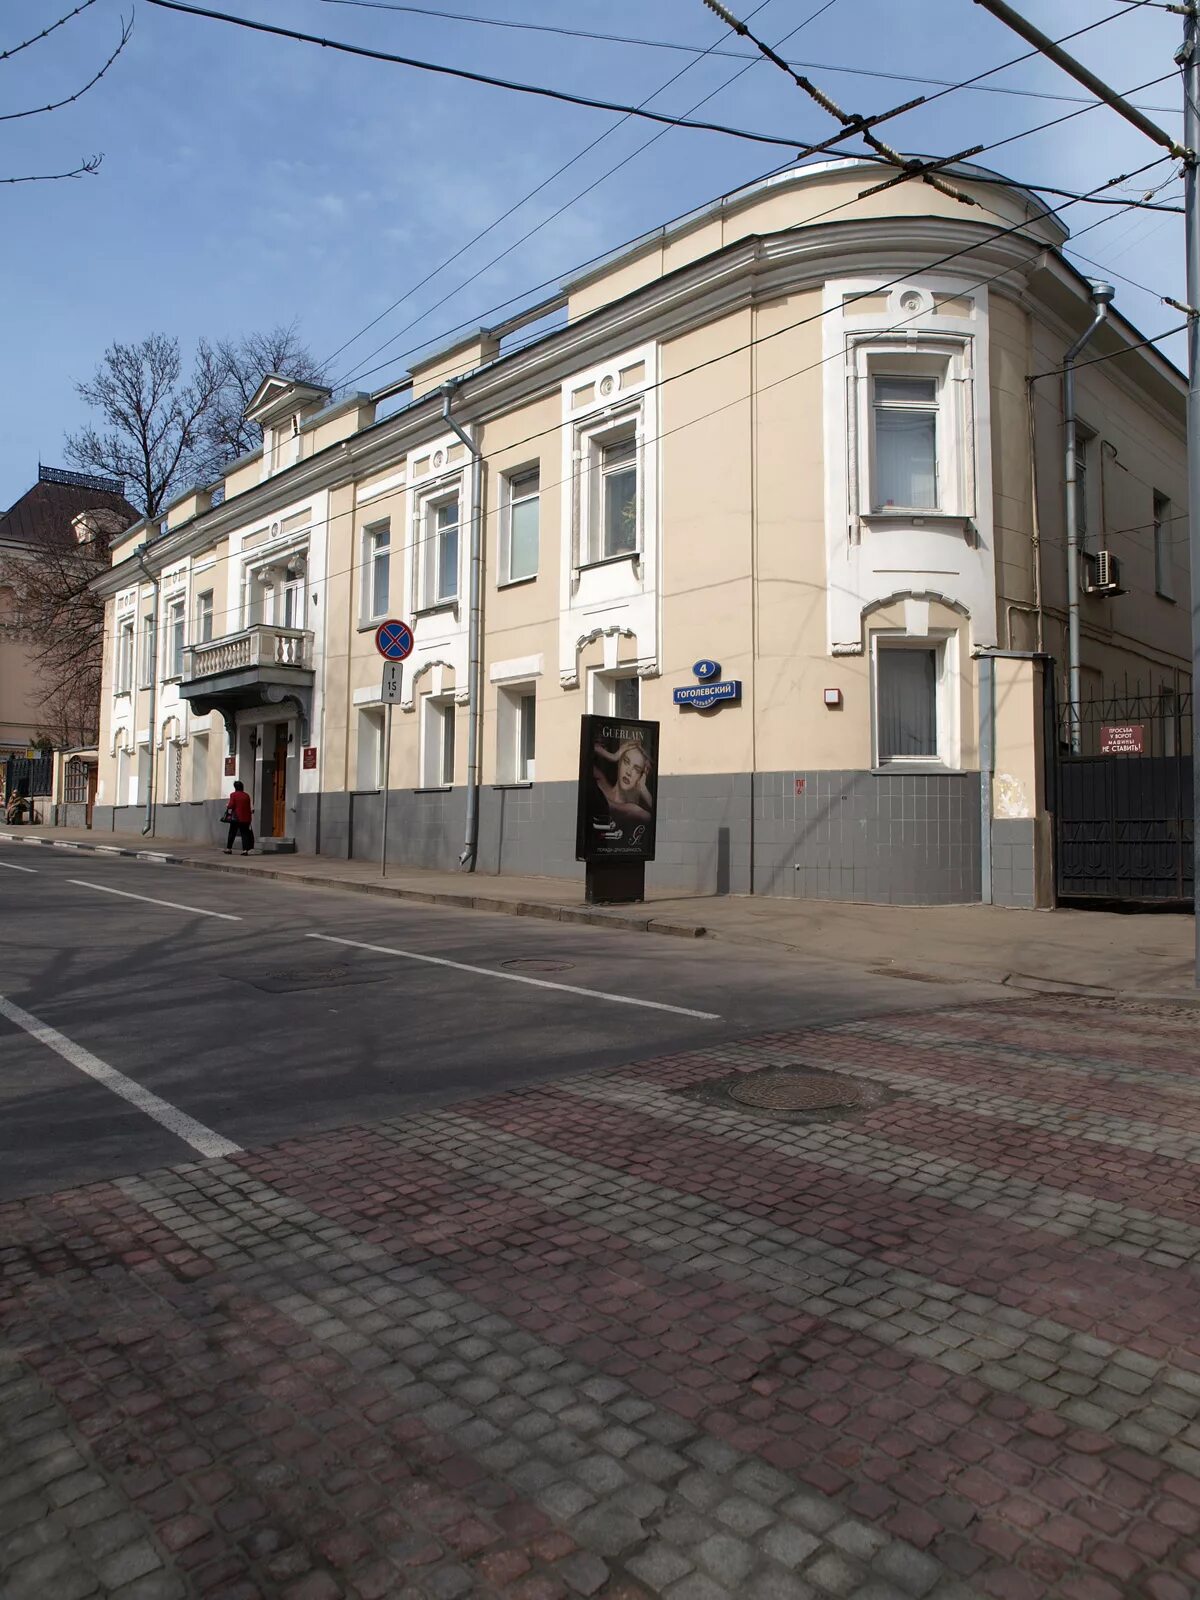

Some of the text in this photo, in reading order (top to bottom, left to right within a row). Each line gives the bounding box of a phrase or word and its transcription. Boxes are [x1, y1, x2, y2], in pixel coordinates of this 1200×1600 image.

[700, 664, 707, 674] 4
[387, 681, 397, 691] 15
[677, 684, 731, 699] ГОГОЛЕВСКИЙ
[602, 726, 645, 741] GUERLAIN
[1111, 743, 1141, 752] СТАВИТЬ!
